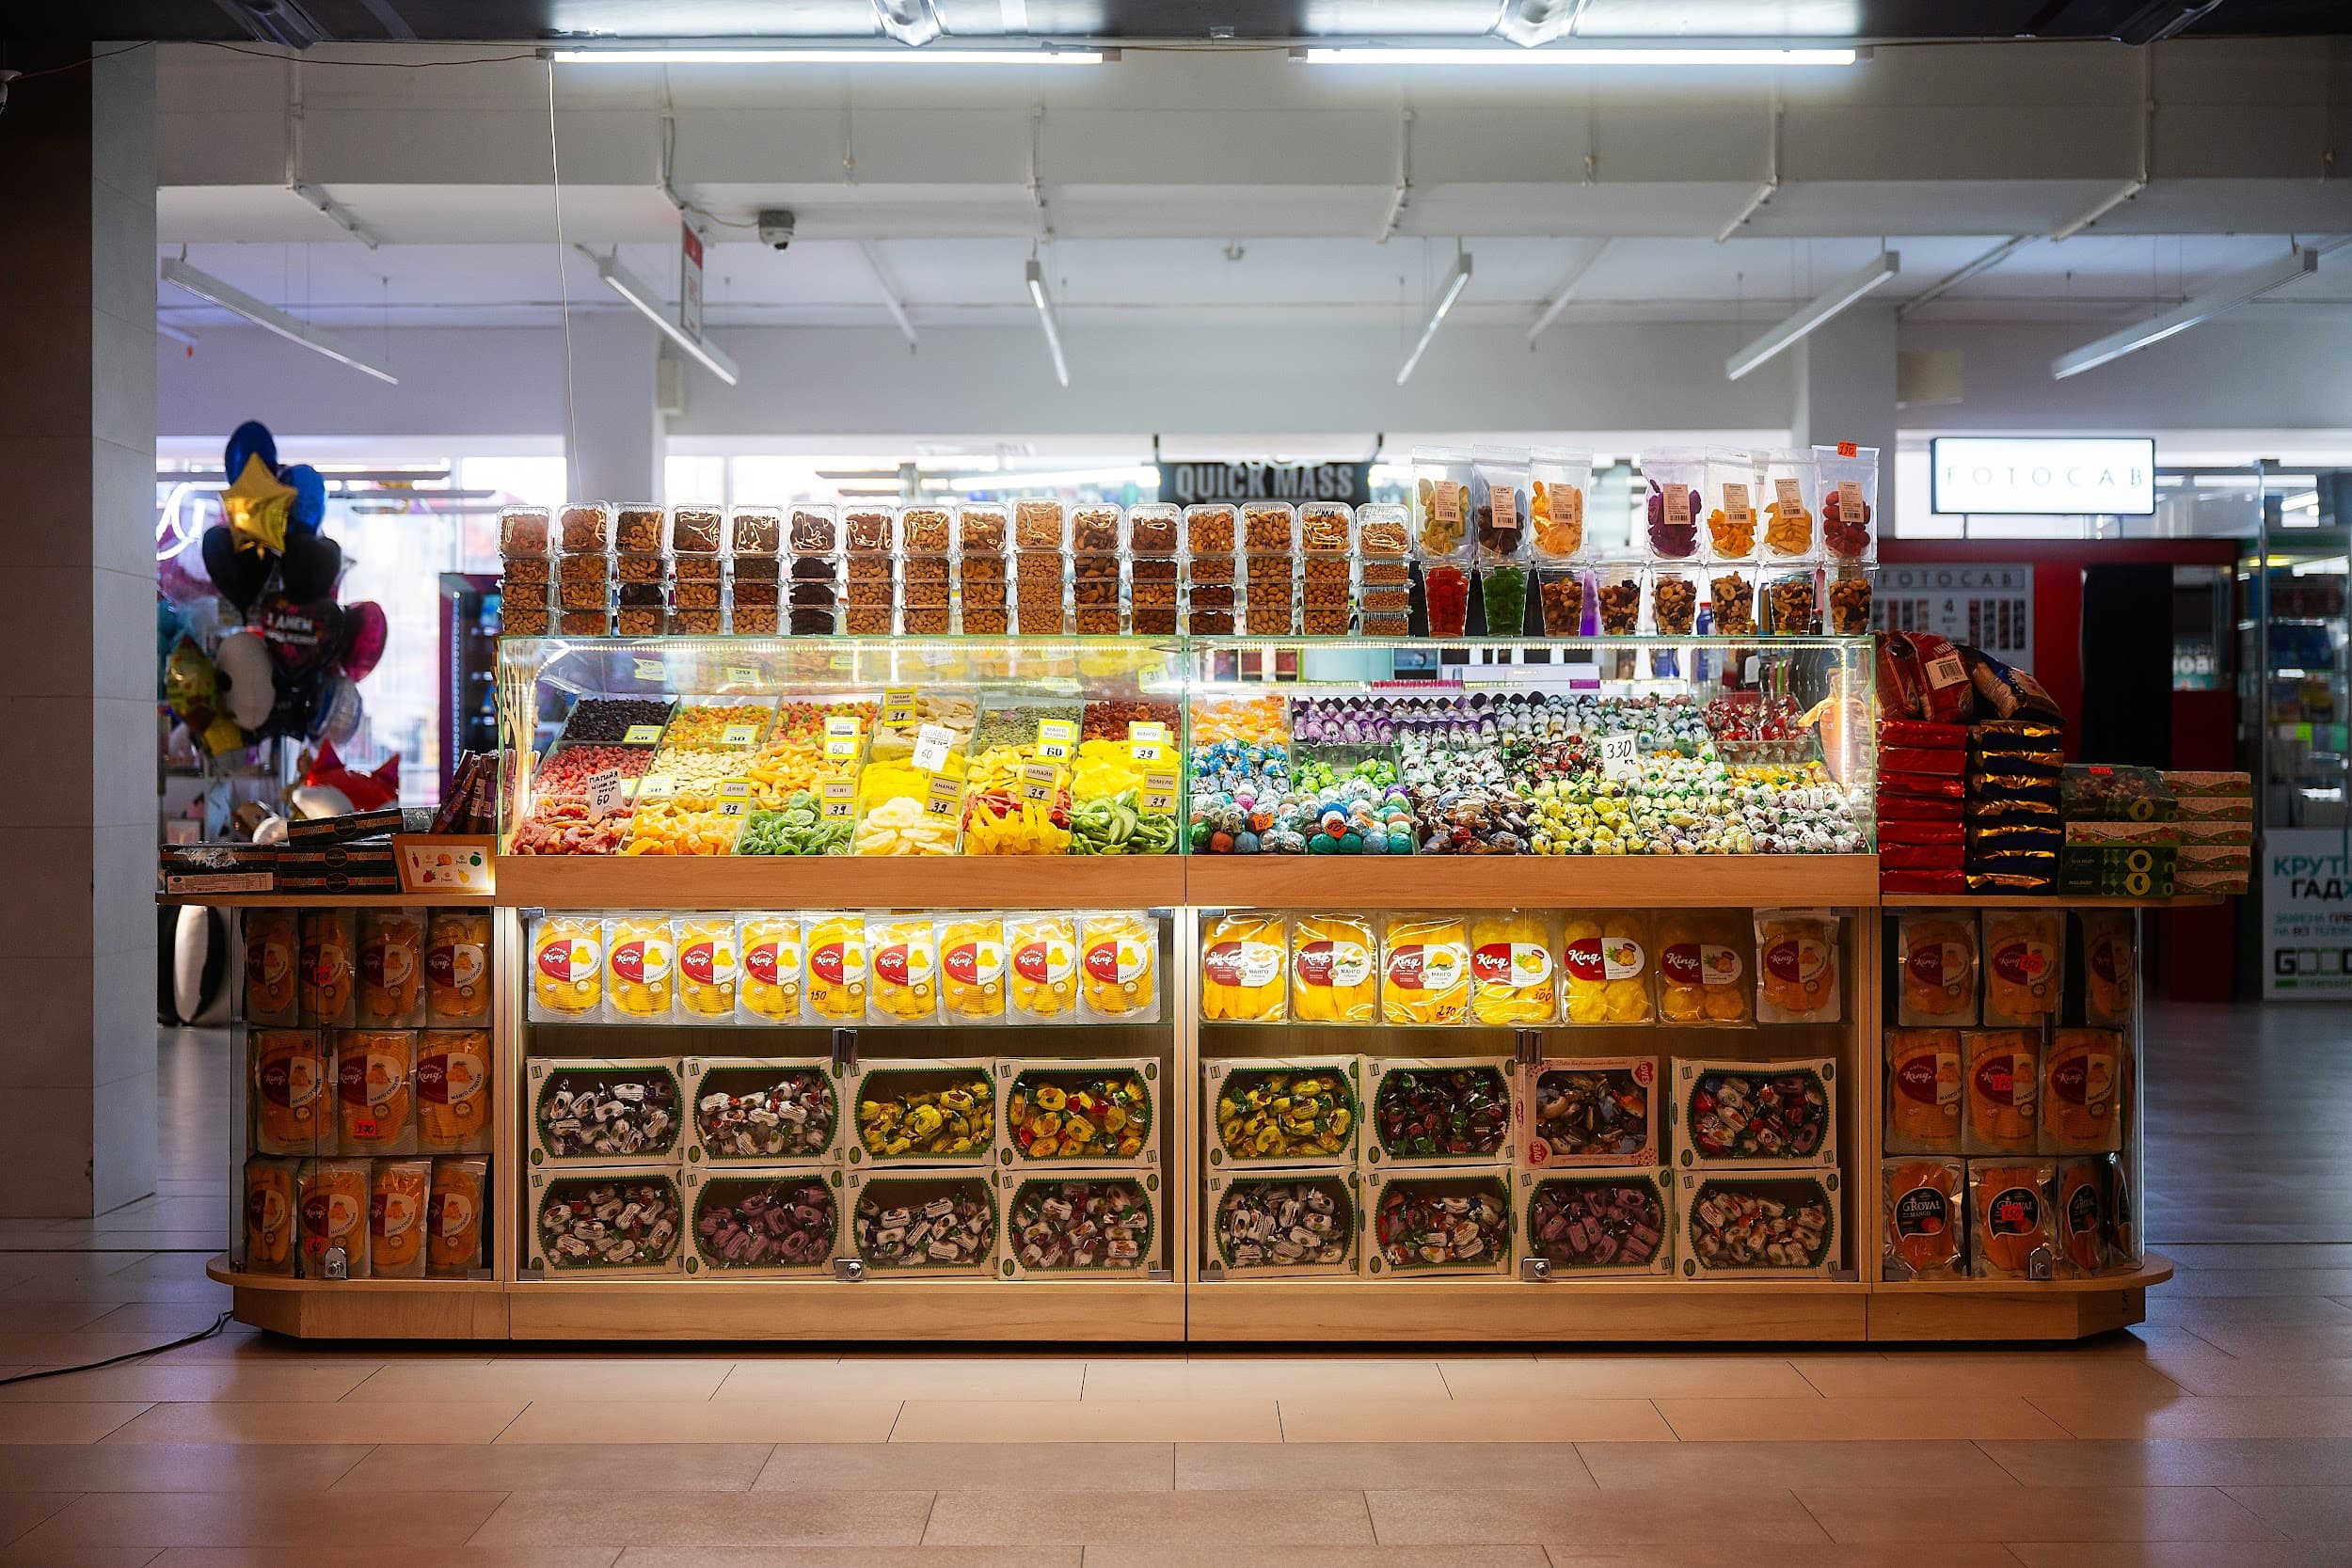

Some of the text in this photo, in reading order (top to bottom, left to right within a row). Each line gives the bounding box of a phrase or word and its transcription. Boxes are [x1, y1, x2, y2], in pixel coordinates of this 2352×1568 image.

[1176, 465, 1354, 500] QUICK MASS
[832, 744, 844, 754] 60
[921, 750, 933, 760] 60
[1046, 747, 1063, 757] 60
[1606, 739, 1632, 760] 330
[934, 782, 958, 792] АНАНАС
[596, 794, 610, 806] 60
[1028, 788, 1045, 800] 39
[930, 801, 948, 814] 39
[1151, 797, 1167, 807] 39
[724, 804, 739, 816] 39
[831, 805, 847, 816] 39
[1258, 818, 1269, 828] 60
[543, 953, 566, 963] King
[616, 954, 640, 965] King
[685, 957, 709, 966] King
[750, 957, 773, 967] King
[815, 956, 839, 967] King
[880, 957, 903, 968] King
[948, 956, 973, 967] King
[1019, 956, 1042, 966] King
[1089, 955, 1113, 966] King
[1392, 954, 1422, 970] King
[1475, 953, 1509, 971] King
[1567, 949, 1601, 966] King
[1665, 952, 1700, 970] King
[1770, 955, 1795, 964] King
[1913, 956, 1939, 968] King
[1997, 956, 2021, 968] King
[428, 958, 451, 971] King
[809, 990, 827, 1002] 150
[1534, 990, 1552, 1002] 300
[1436, 1005, 1456, 1017] 270
[340, 1071, 362, 1084] King
[418, 1070, 442, 1084] King
[1640, 1060, 1652, 1085] LOVES
[1902, 1070, 1932, 1084] King
[2057, 1070, 2083, 1084] King
[1533, 1141, 1544, 1165] LOVES
[1902, 1198, 1942, 1212] ROYAL
[2003, 1208, 2023, 1220] 150
